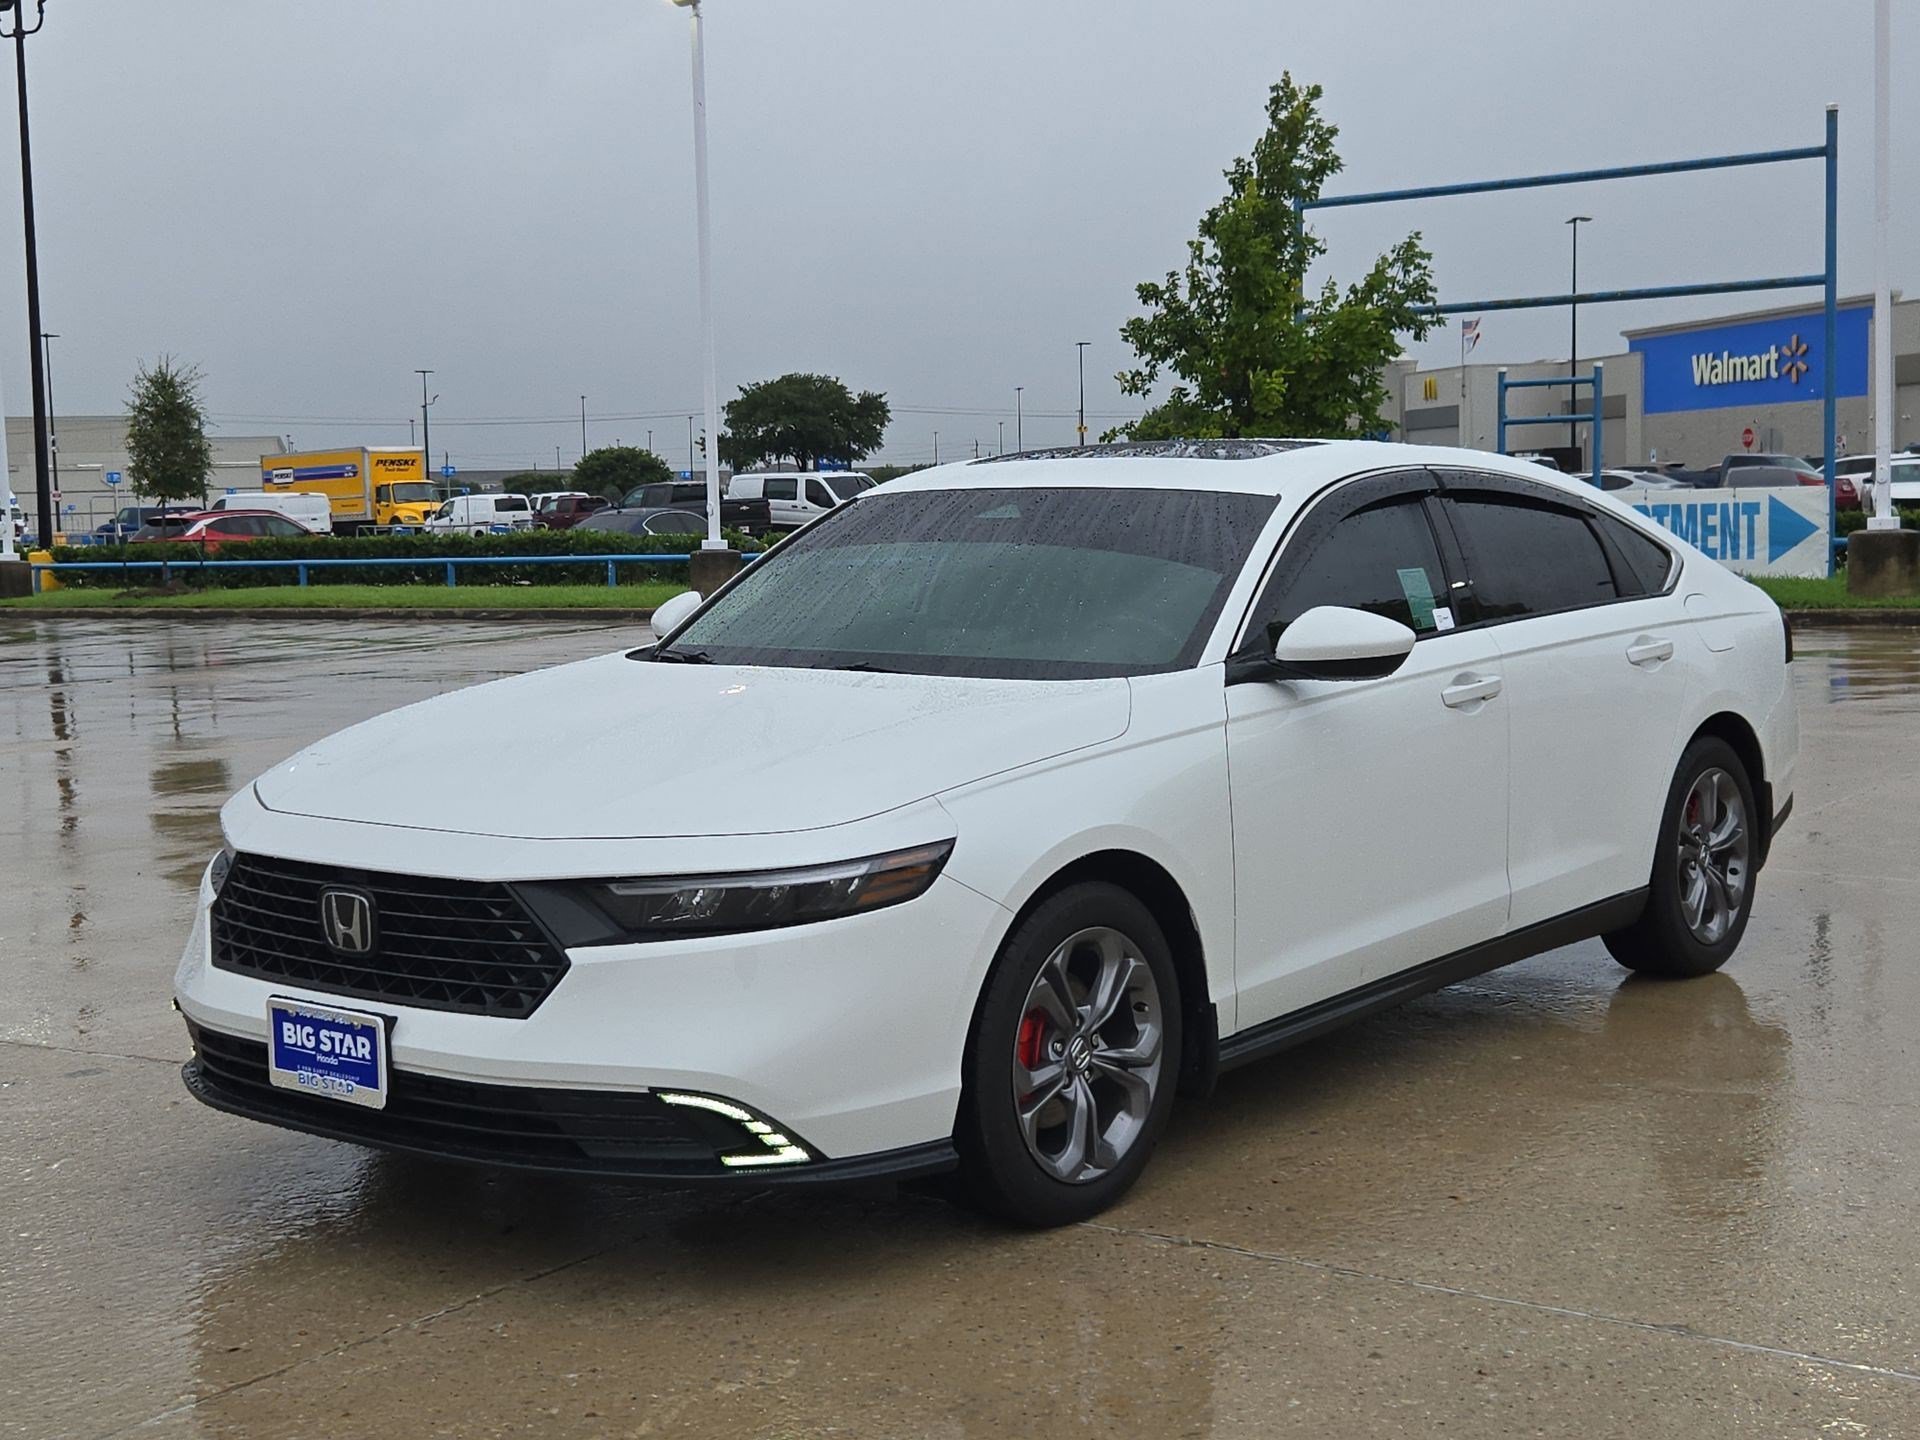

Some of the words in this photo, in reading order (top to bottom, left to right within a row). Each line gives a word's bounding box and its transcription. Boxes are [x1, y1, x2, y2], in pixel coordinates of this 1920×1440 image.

[1691, 344, 1779, 386] Walmart
[375, 458, 417, 467] PENSKE
[1632, 502, 1761, 560] TMENT
[282, 1021, 316, 1049] BIG
[319, 1028, 371, 1060] STAR
[316, 1053, 339, 1065] Honda
[298, 1073, 319, 1088] BIG
